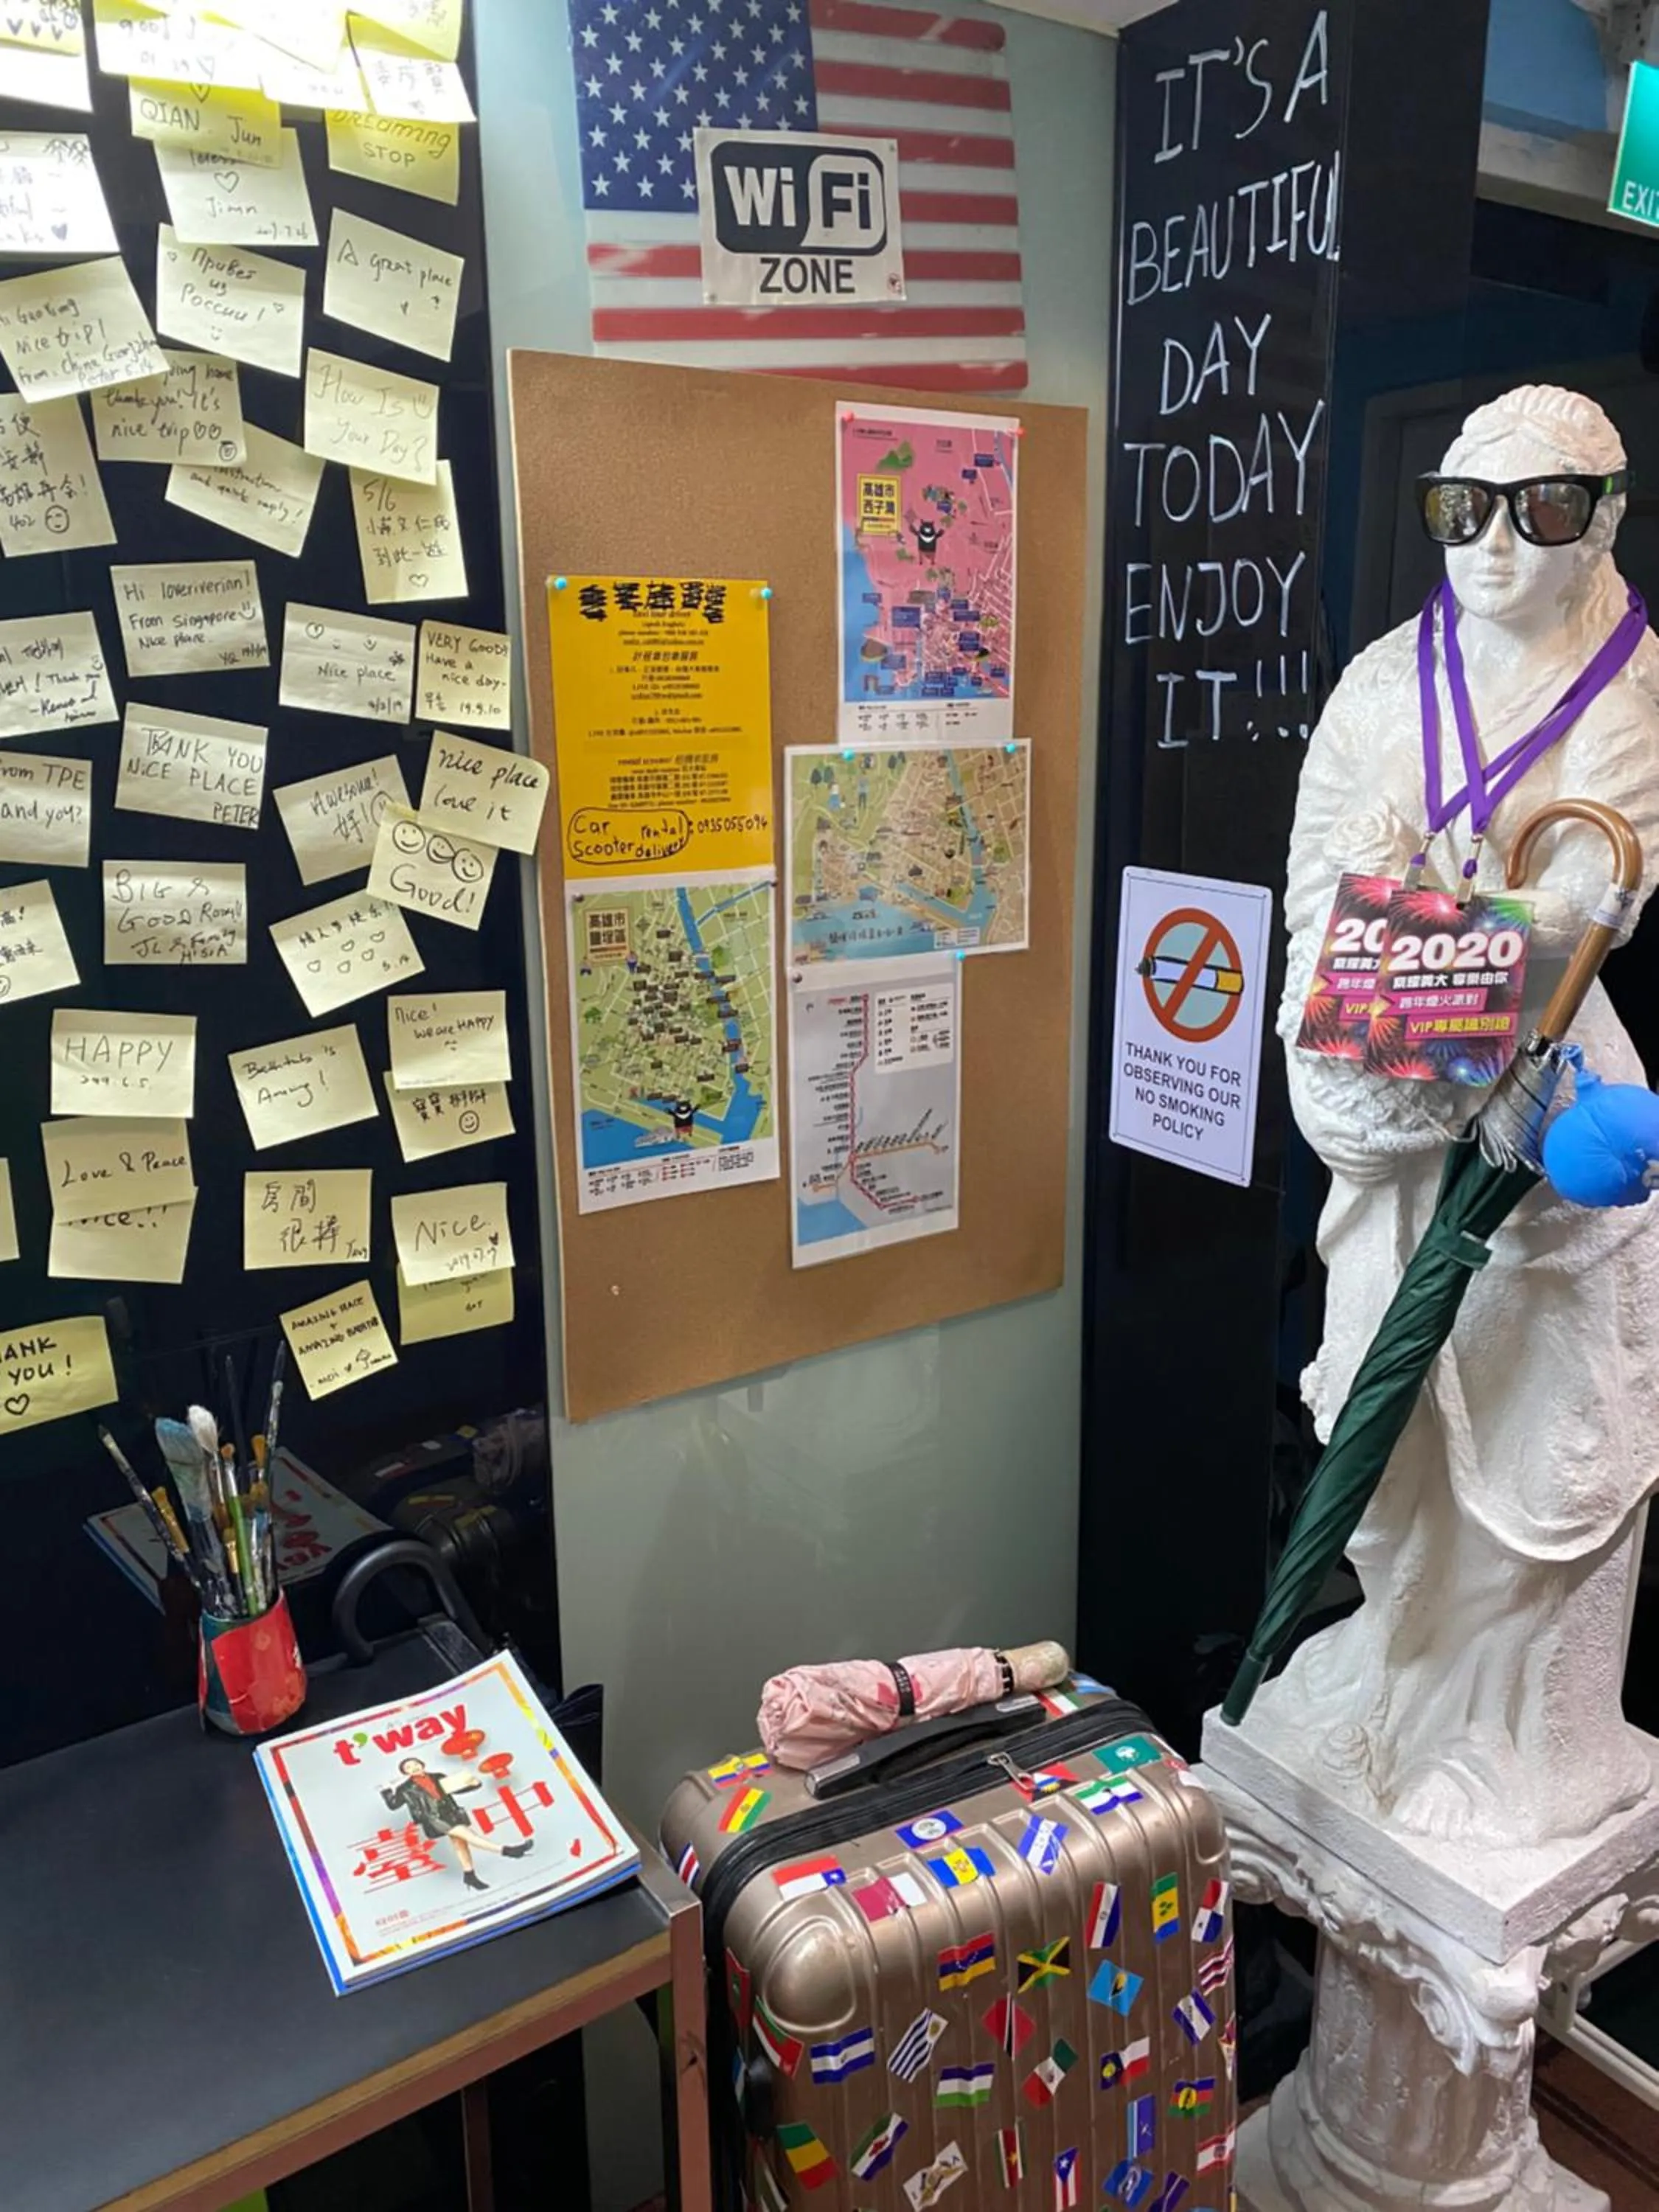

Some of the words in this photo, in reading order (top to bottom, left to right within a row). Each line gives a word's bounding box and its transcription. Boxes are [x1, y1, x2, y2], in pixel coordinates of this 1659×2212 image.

[1155, 35, 1272, 163] IT'S
[1284, 10, 1328, 122] A
[140, 97, 201, 131] QIAN
[363, 142, 416, 168] STOP
[1127, 150, 1340, 305] BEAUTIFUL
[759, 257, 855, 294] ZONE
[1160, 314, 1272, 415] DAY
[1124, 399, 1326, 527] TODAY
[124, 582, 145, 602] Hi
[1125, 552, 1307, 644] ENJOY
[425, 630, 462, 654] VERY
[318, 662, 347, 680] Nice
[356, 664, 396, 684] place
[227, 746, 263, 773] YOU
[42, 763, 86, 791] TPE
[189, 767, 258, 797] PLACE
[212, 801, 260, 827] PETER
[573, 814, 611, 835] Car
[1387, 930, 1524, 971] 2020
[64, 1034, 174, 1073] HAPPY
[1125, 1042, 1174, 1068] THANK
[1178, 1055, 1208, 1077] YOU
[1210, 1064, 1242, 1087] FOR
[1123, 1062, 1205, 1099] OBSERVING
[1208, 1085, 1242, 1110] OUR
[1134, 1086, 1157, 1105] NO
[1158, 1093, 1225, 1127] SMOKING
[1152, 1113, 1205, 1141] POLICY
[60, 1155, 112, 1189] Love
[0, 1335, 58, 1363] ANK
